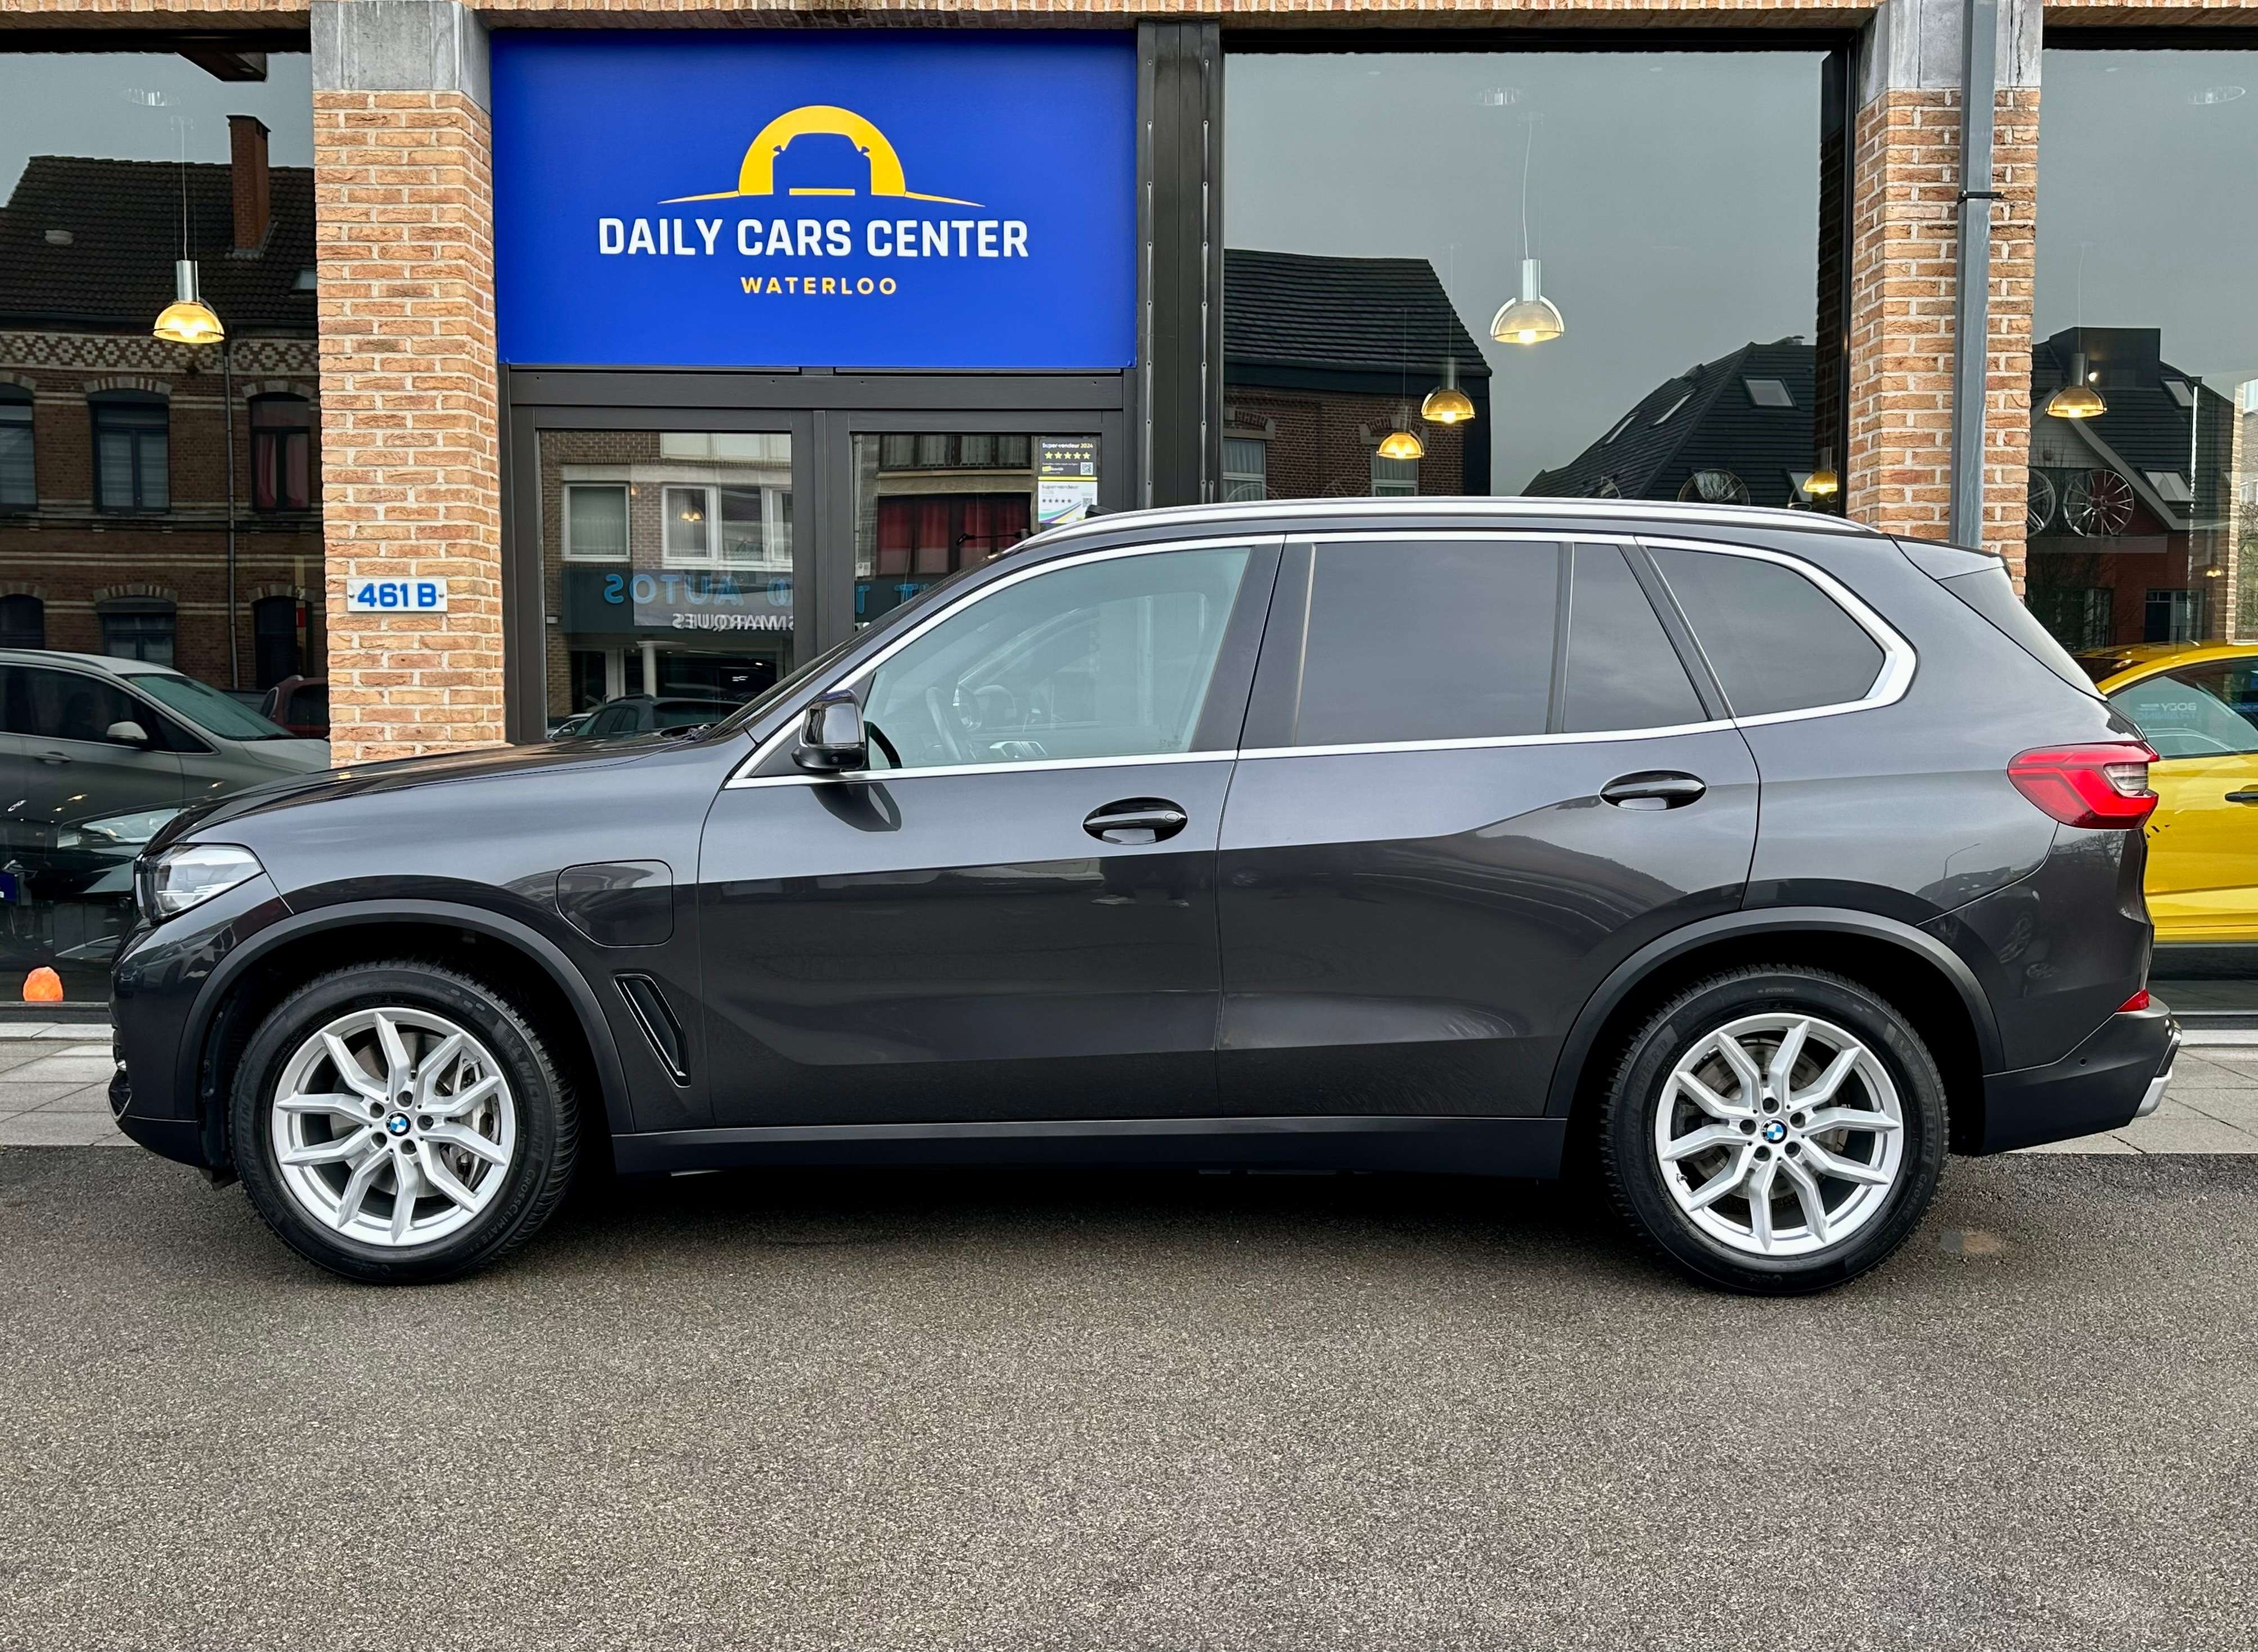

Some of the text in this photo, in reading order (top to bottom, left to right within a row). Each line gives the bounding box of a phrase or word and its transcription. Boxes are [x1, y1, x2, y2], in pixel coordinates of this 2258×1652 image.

[599, 218, 1029, 257] DAILY CARS CENTER
[741, 277, 895, 295] WATERLOO
[356, 582, 437, 608] 461 B
